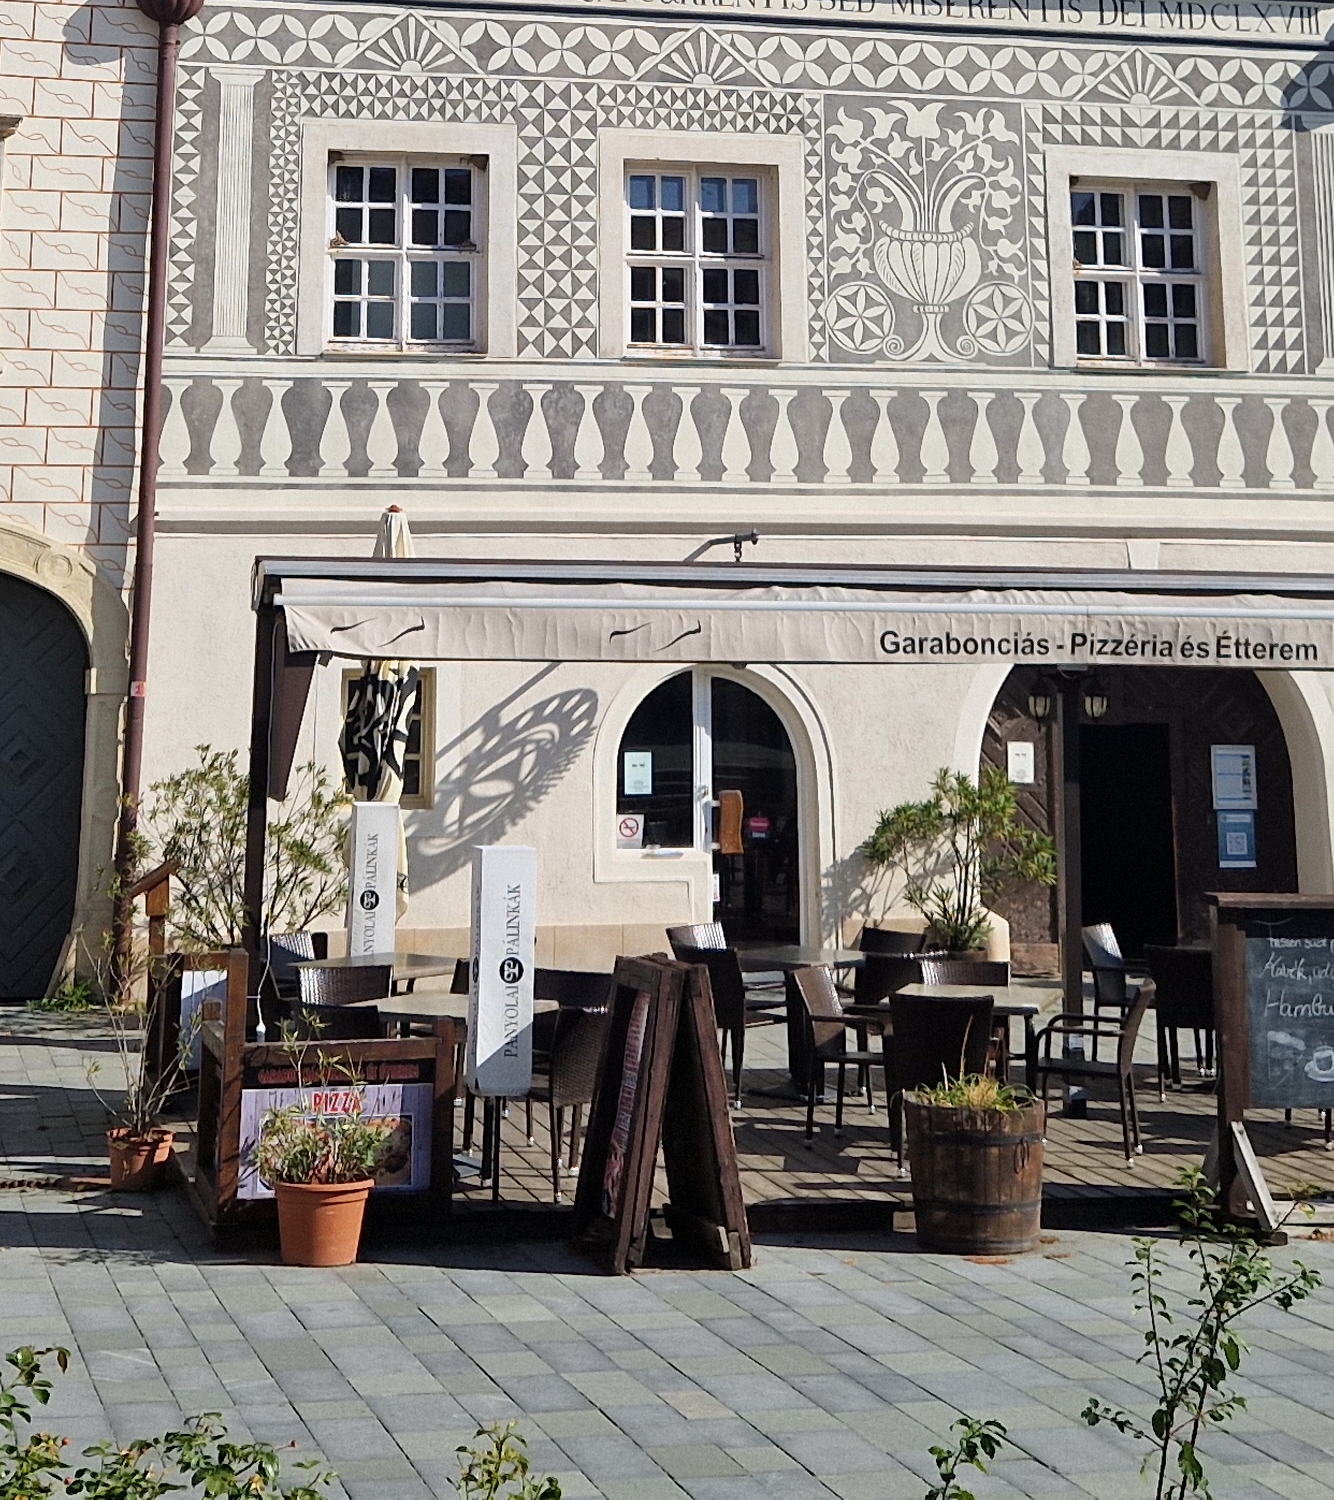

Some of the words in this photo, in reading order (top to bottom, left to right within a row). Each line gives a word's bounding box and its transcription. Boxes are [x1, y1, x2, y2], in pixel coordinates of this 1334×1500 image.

[879, 629, 1050, 656] Garabonciás
[1070, 632, 1173, 659] Pizzéria
[1180, 631, 1210, 660] és
[1215, 630, 1319, 661] Étterem
[505, 883, 521, 956] PÁLINKÁK
[503, 985, 520, 1058] PANYOLAI
[312, 1090, 363, 1114] PIZZA
